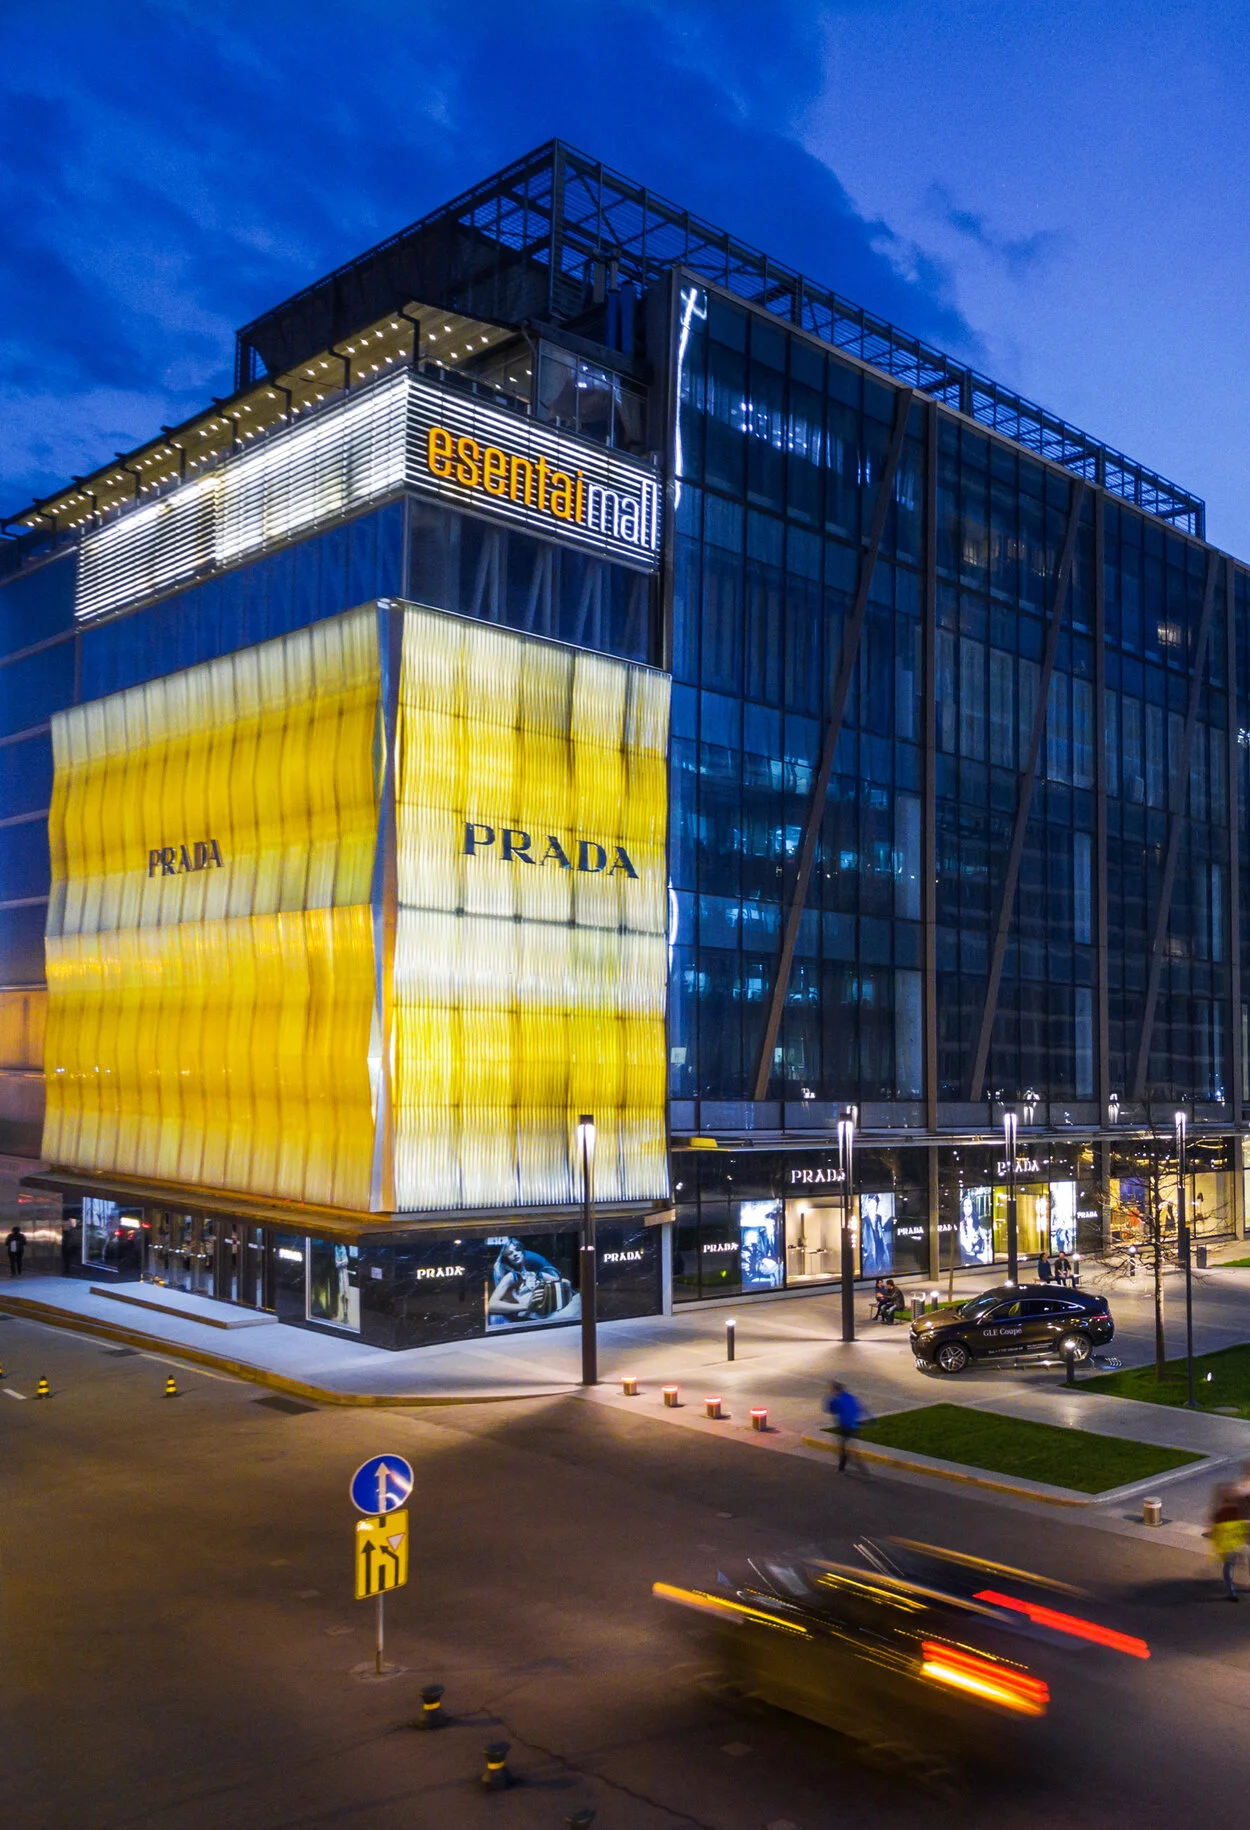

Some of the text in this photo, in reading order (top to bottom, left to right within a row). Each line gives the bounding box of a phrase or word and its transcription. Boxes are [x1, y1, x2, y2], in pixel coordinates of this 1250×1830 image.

[462, 821, 640, 880] PRADA
[147, 838, 224, 878] PRADA
[997, 1159, 1040, 1173] PADA
[1076, 1210, 1098, 1219] PRADA
[897, 1226, 924, 1236] PRADA
[703, 1242, 739, 1253] PRADA
[604, 1250, 642, 1263] PRADA
[416, 1265, 464, 1280] PRADA
[982, 1328, 998, 1337] GLE
